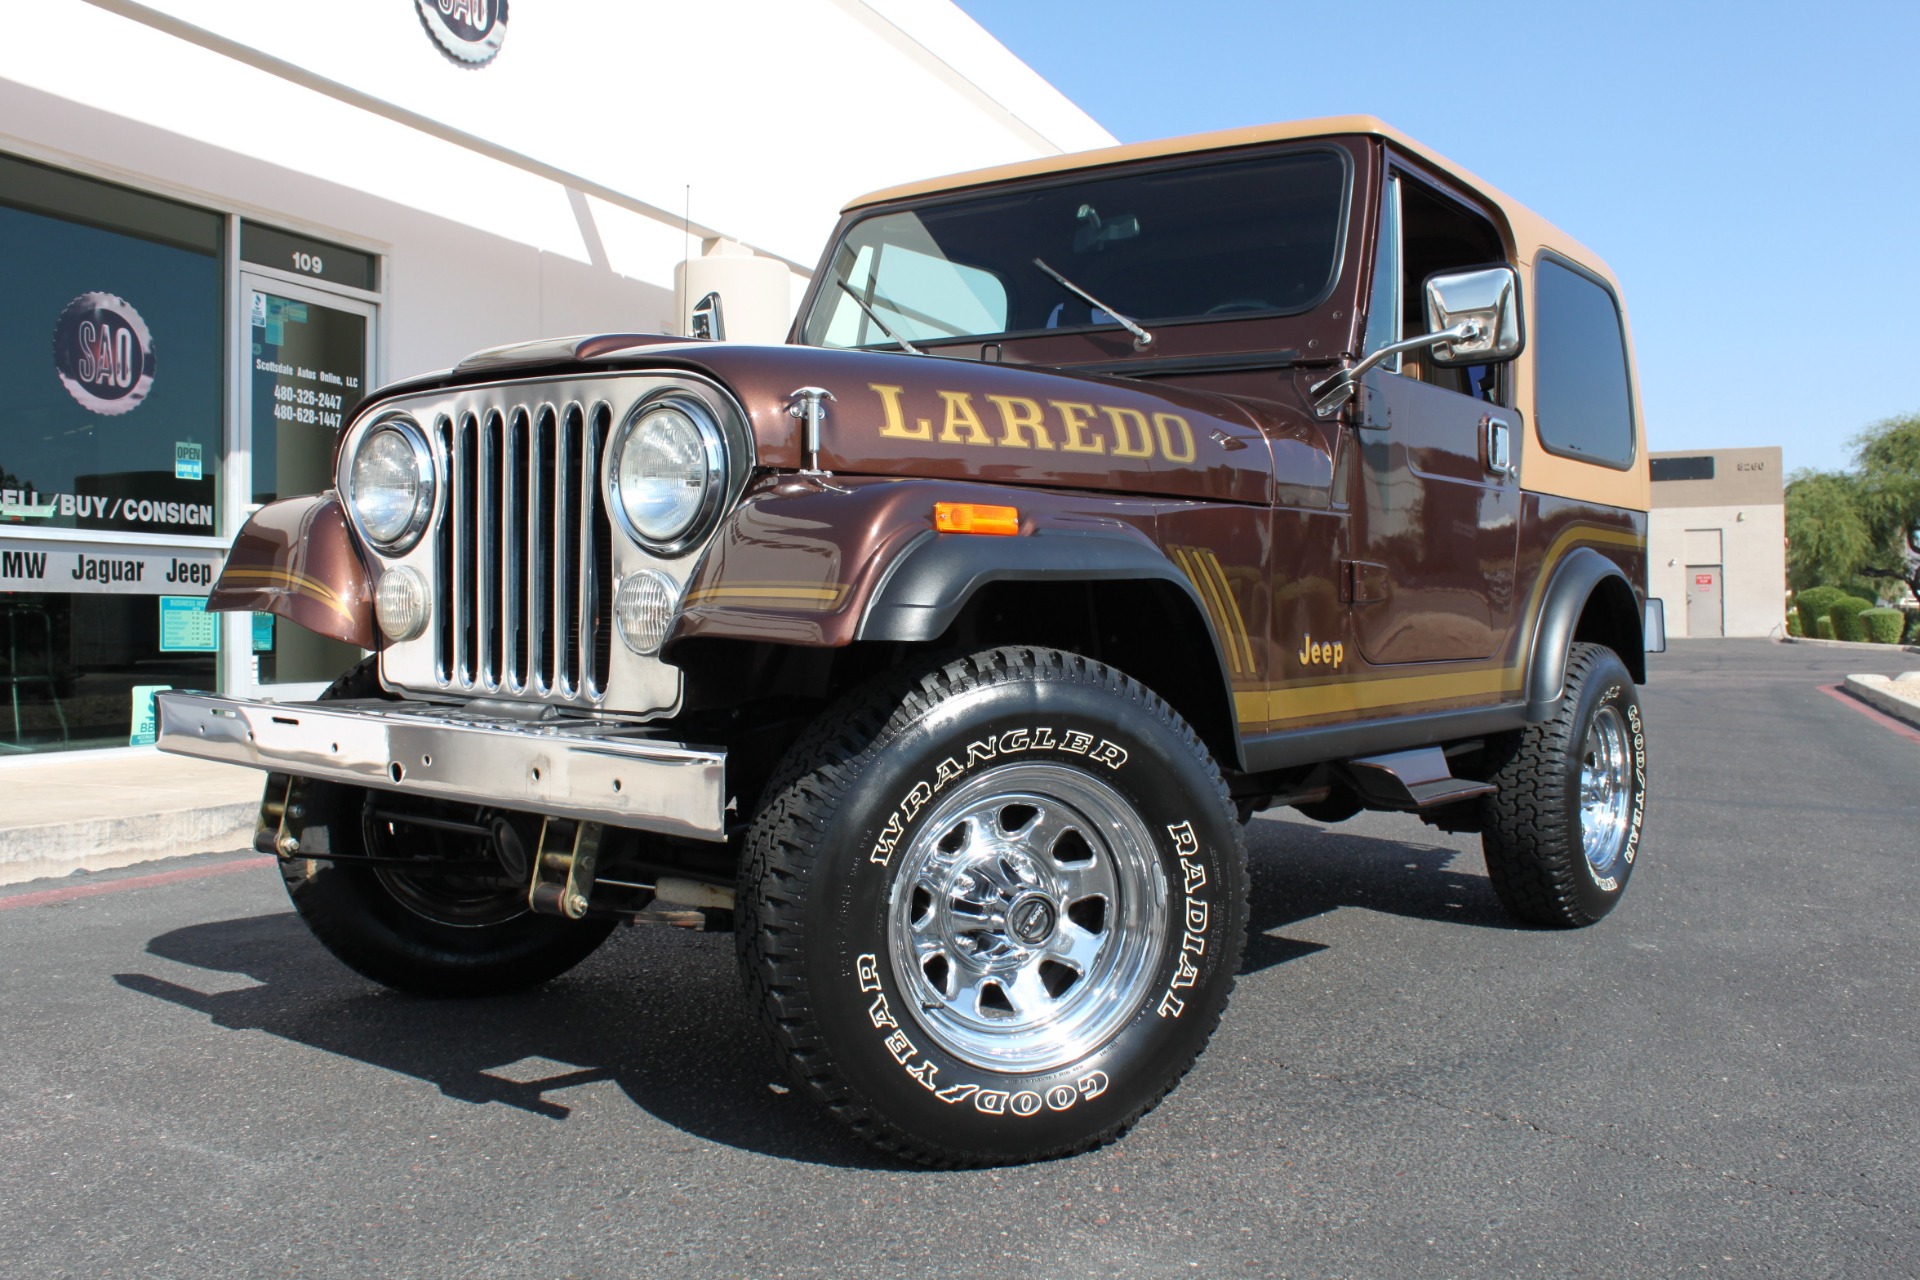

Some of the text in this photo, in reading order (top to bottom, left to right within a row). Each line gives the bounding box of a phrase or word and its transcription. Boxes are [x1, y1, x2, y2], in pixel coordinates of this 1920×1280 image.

[292, 251, 323, 274] 109
[79, 321, 132, 388] SAO
[256, 358, 358, 388] Scottsdale Autos Online, LLC
[274, 384, 342, 410] 480-326-2447
[274, 403, 342, 428] 480-628-1447
[867, 382, 1197, 464] LAREDO
[177, 446, 200, 460] OPEN
[72, 554, 144, 584] Jaguar
[166, 558, 211, 586] Jeep
[1299, 632, 1344, 669] Jeep
[870, 727, 1129, 866] WRANGLER
[1624, 704, 1647, 864] GOODYEAR
[1157, 820, 1208, 1018] RADIAL
[857, 953, 1109, 1116] GOODYEAR
